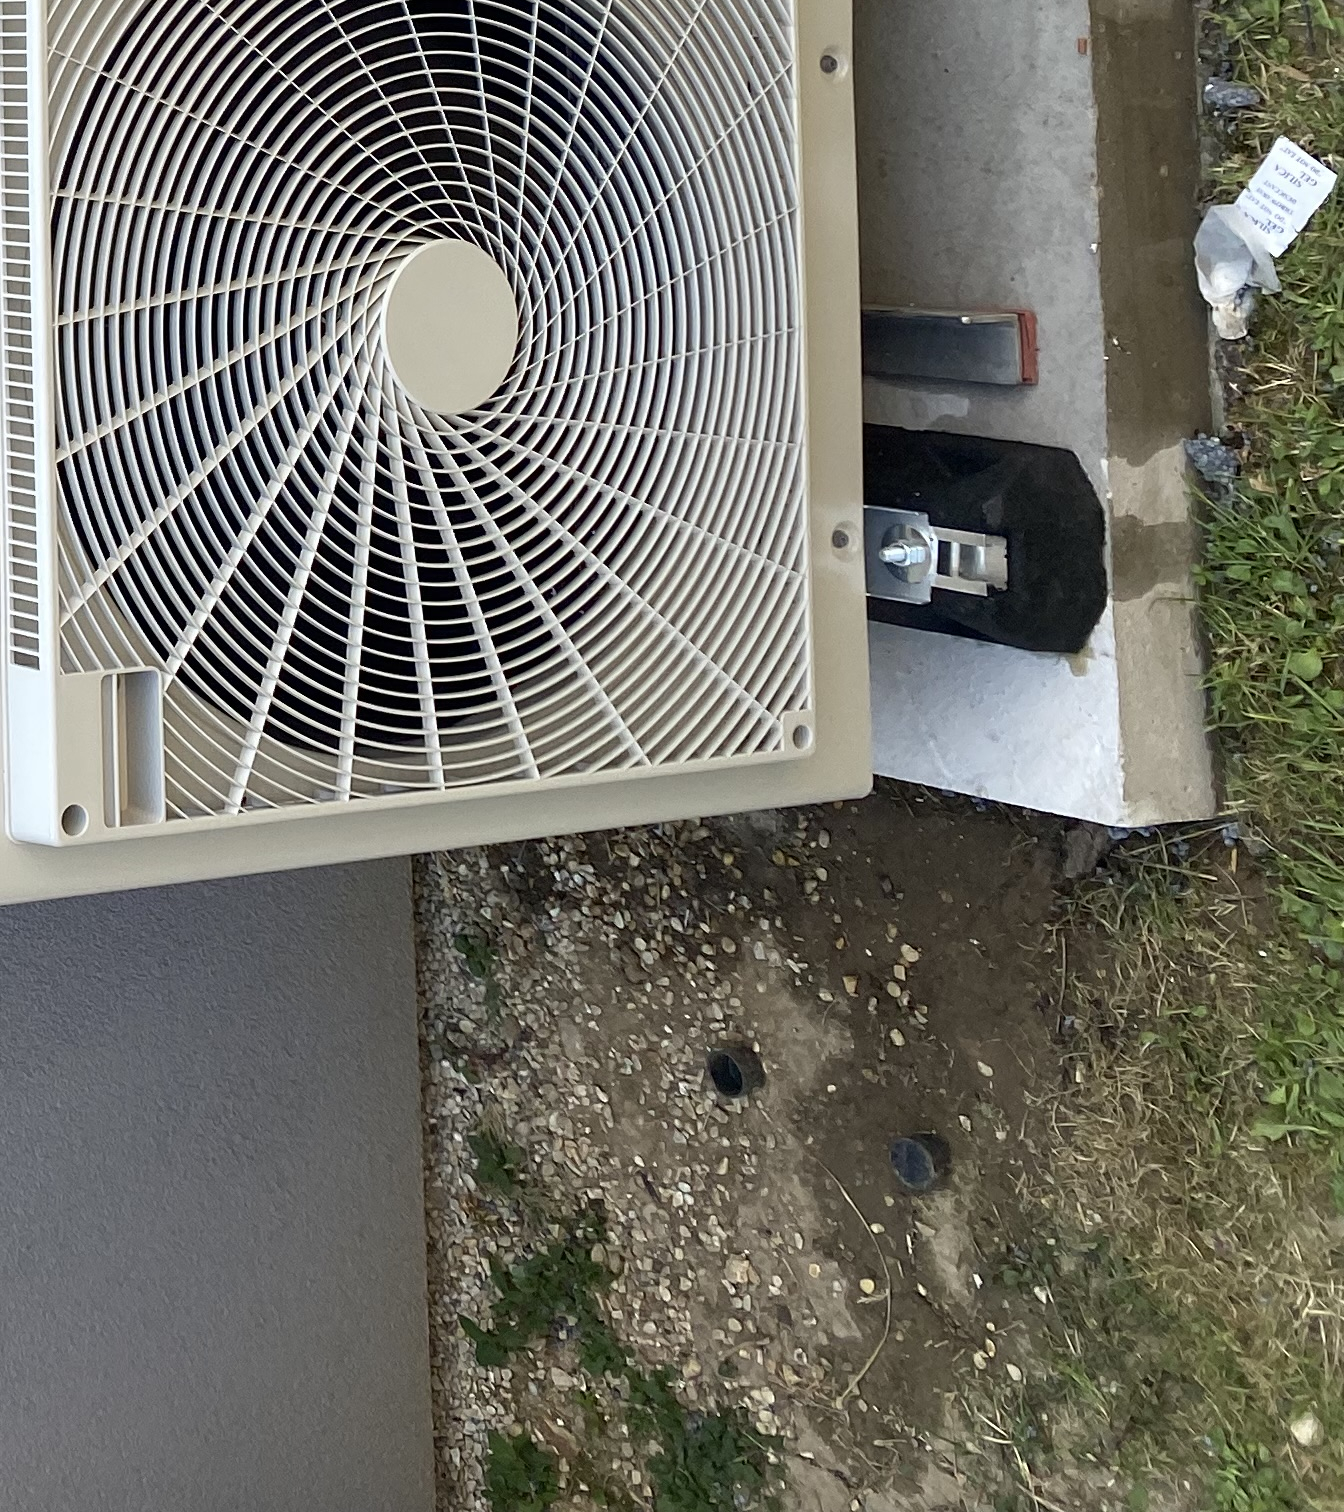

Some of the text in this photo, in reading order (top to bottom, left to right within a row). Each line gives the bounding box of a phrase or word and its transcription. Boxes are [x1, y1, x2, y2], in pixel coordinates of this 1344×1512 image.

[1296, 156, 1309, 167] NOT
[1274, 164, 1302, 188] SILICA
[1299, 171, 1318, 187] GEL
